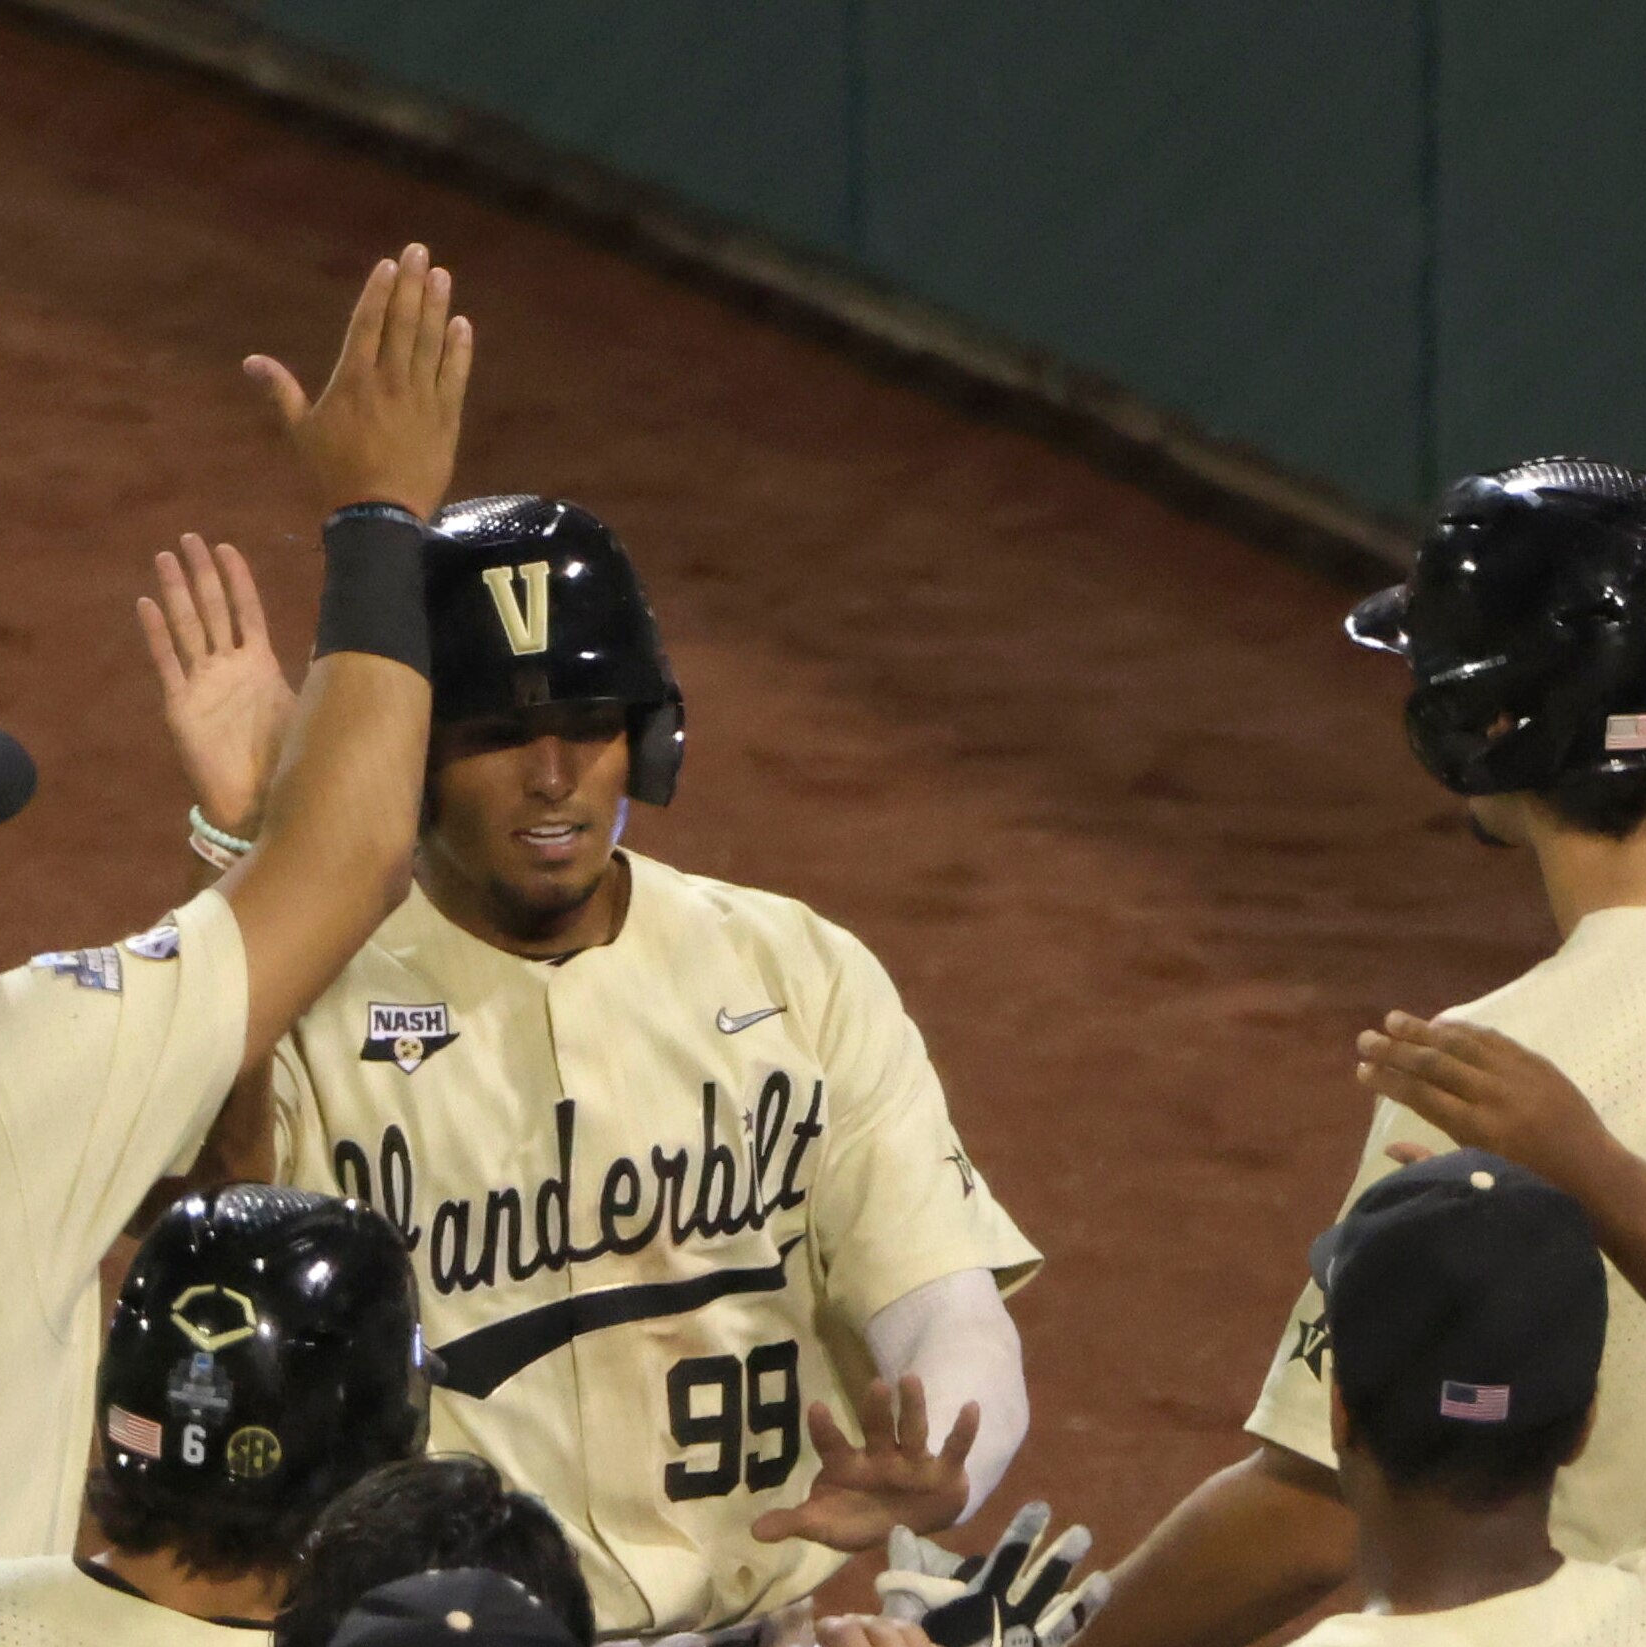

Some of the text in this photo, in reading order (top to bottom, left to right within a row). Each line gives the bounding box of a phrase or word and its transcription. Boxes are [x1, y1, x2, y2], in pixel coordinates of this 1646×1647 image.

[482, 560, 550, 656] V
[373, 1009, 443, 1032] NASH
[182, 1424, 207, 1466] 6
[664, 1338, 802, 1502] 99
